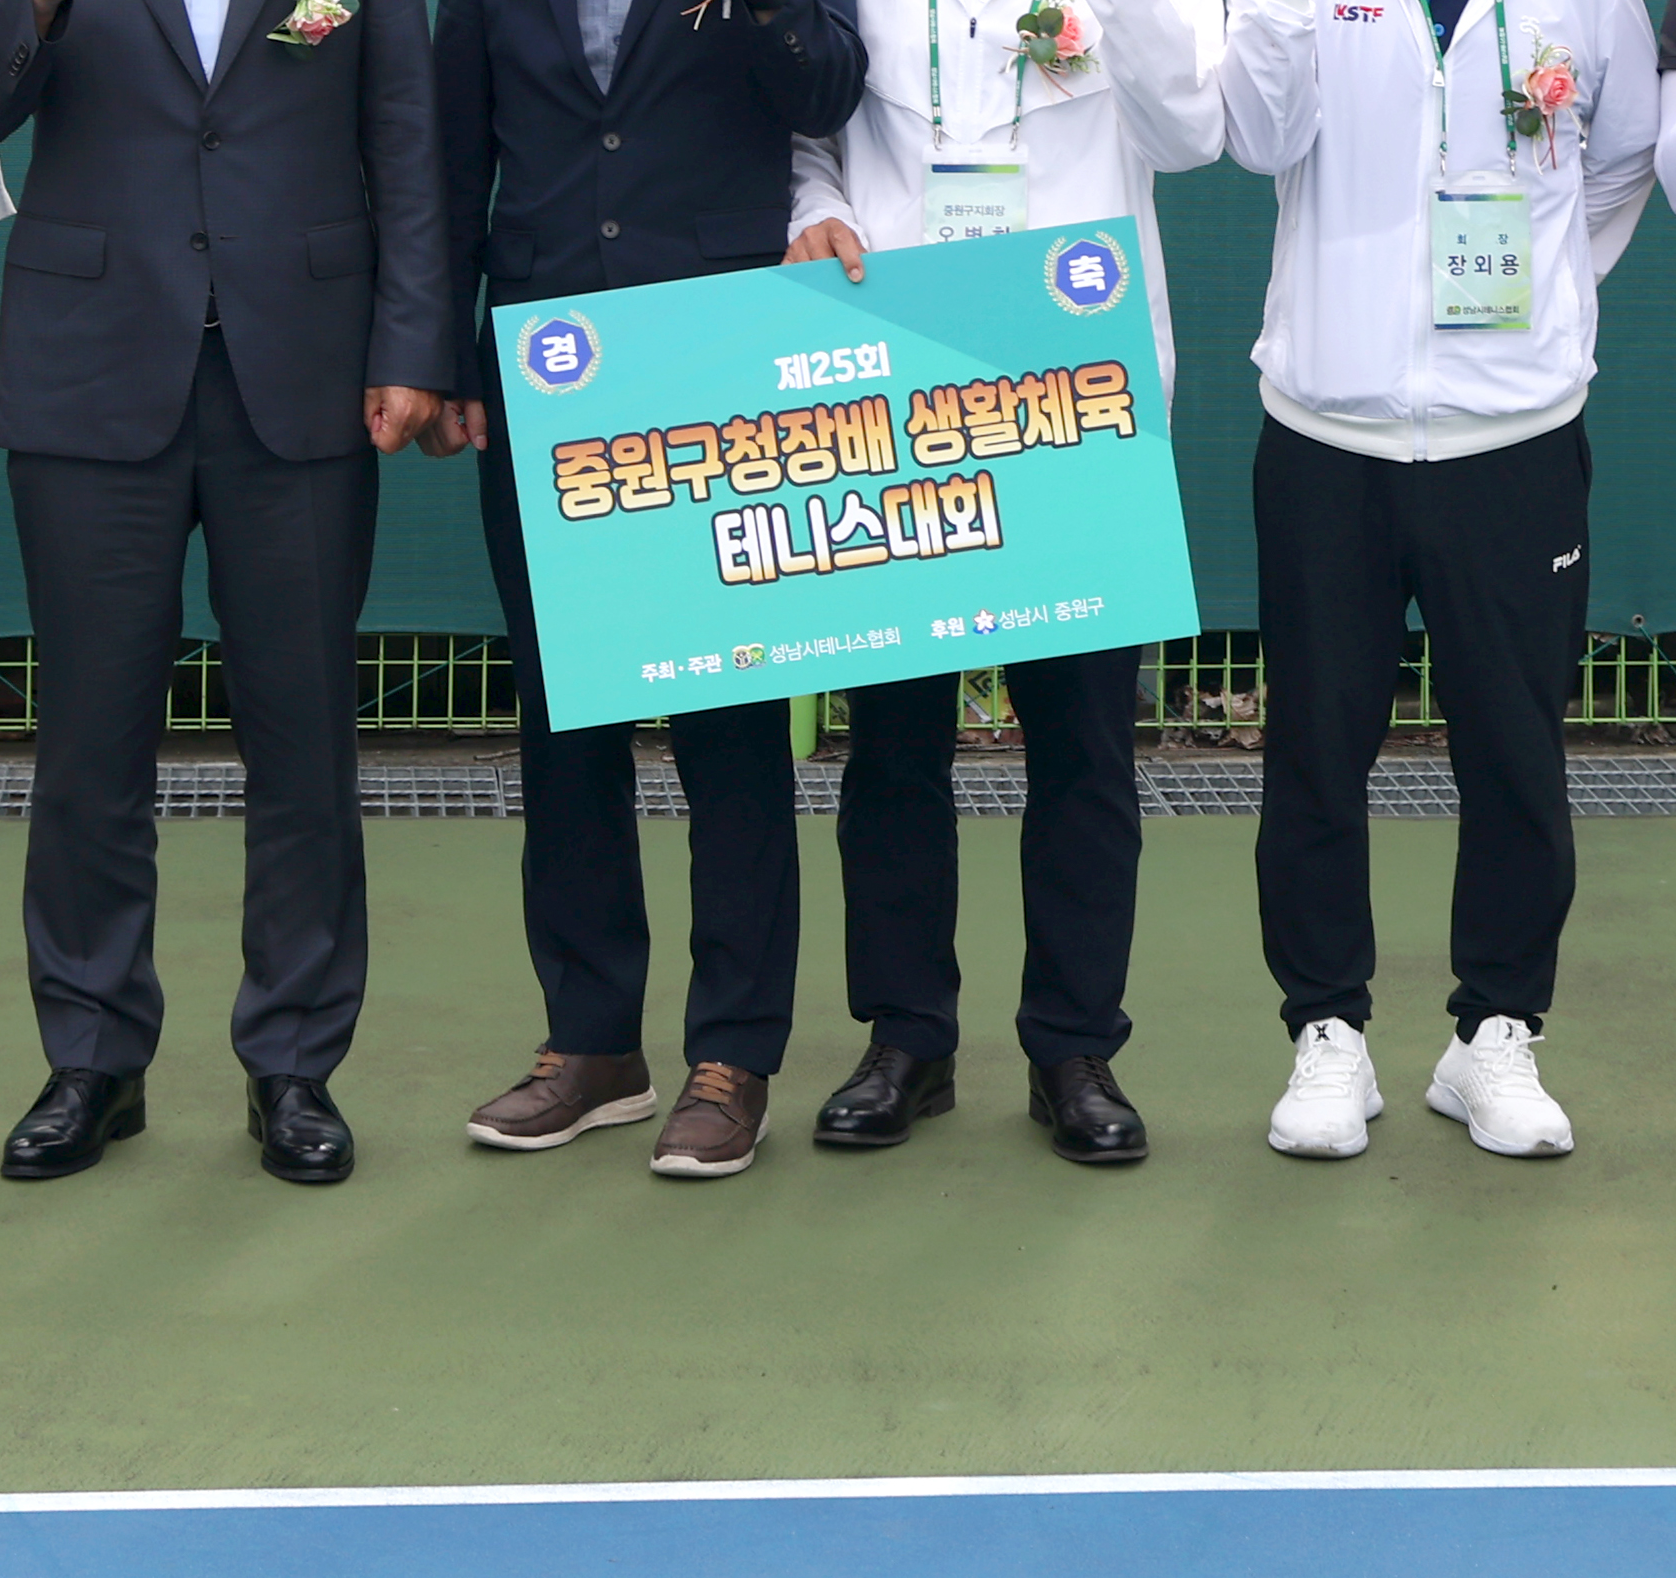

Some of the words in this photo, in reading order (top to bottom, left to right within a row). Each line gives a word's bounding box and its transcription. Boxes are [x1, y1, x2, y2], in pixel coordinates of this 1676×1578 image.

[1333, 4, 1385, 23] KSTF
[943, 205, 1006, 217] 중원구지회장
[1068, 255, 1107, 292] 축
[541, 333, 579, 373] 경
[773, 340, 892, 391] 제25회
[552, 393, 899, 521] 중원구청장배
[904, 360, 1137, 468] 생활체육
[712, 468, 1004, 585] 테니스대회
[1552, 544, 1582, 573] FILA
[930, 616, 966, 640] 후원
[998, 604, 1050, 631] 성남시
[1054, 596, 1105, 622] 중원구
[768, 627, 902, 664] 성남시테니스협회
